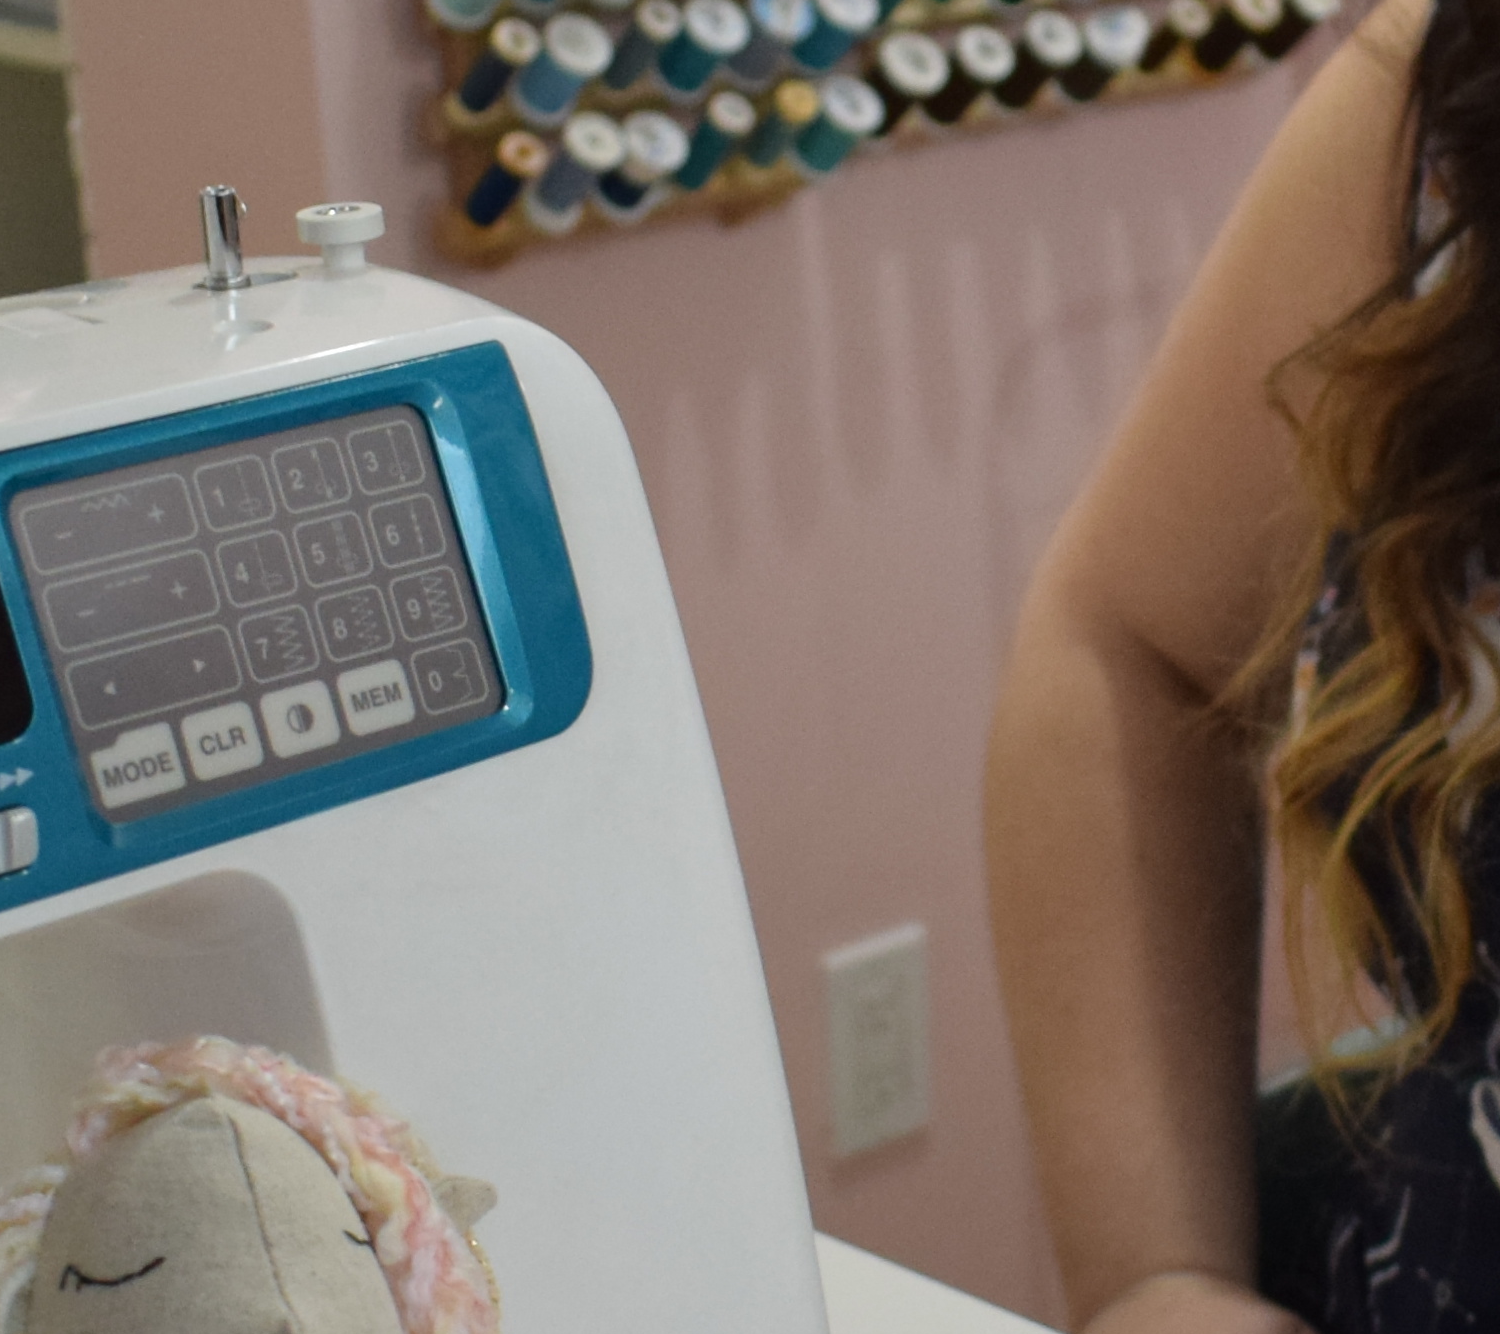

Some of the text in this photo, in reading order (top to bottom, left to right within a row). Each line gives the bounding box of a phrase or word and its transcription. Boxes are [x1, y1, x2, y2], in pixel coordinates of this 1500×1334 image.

[363, 451, 380, 472] 3
[288, 469, 304, 490] 2
[212, 488, 225, 507] 1
[385, 524, 400, 545] 6
[310, 542, 326, 565] 5
[234, 562, 249, 583] 4
[406, 598, 421, 619] 9
[332, 618, 348, 639] 8
[254, 637, 268, 660] 7
[350, 681, 402, 713] MEM
[200, 726, 246, 758] CLR
[102, 752, 174, 789] MODE
